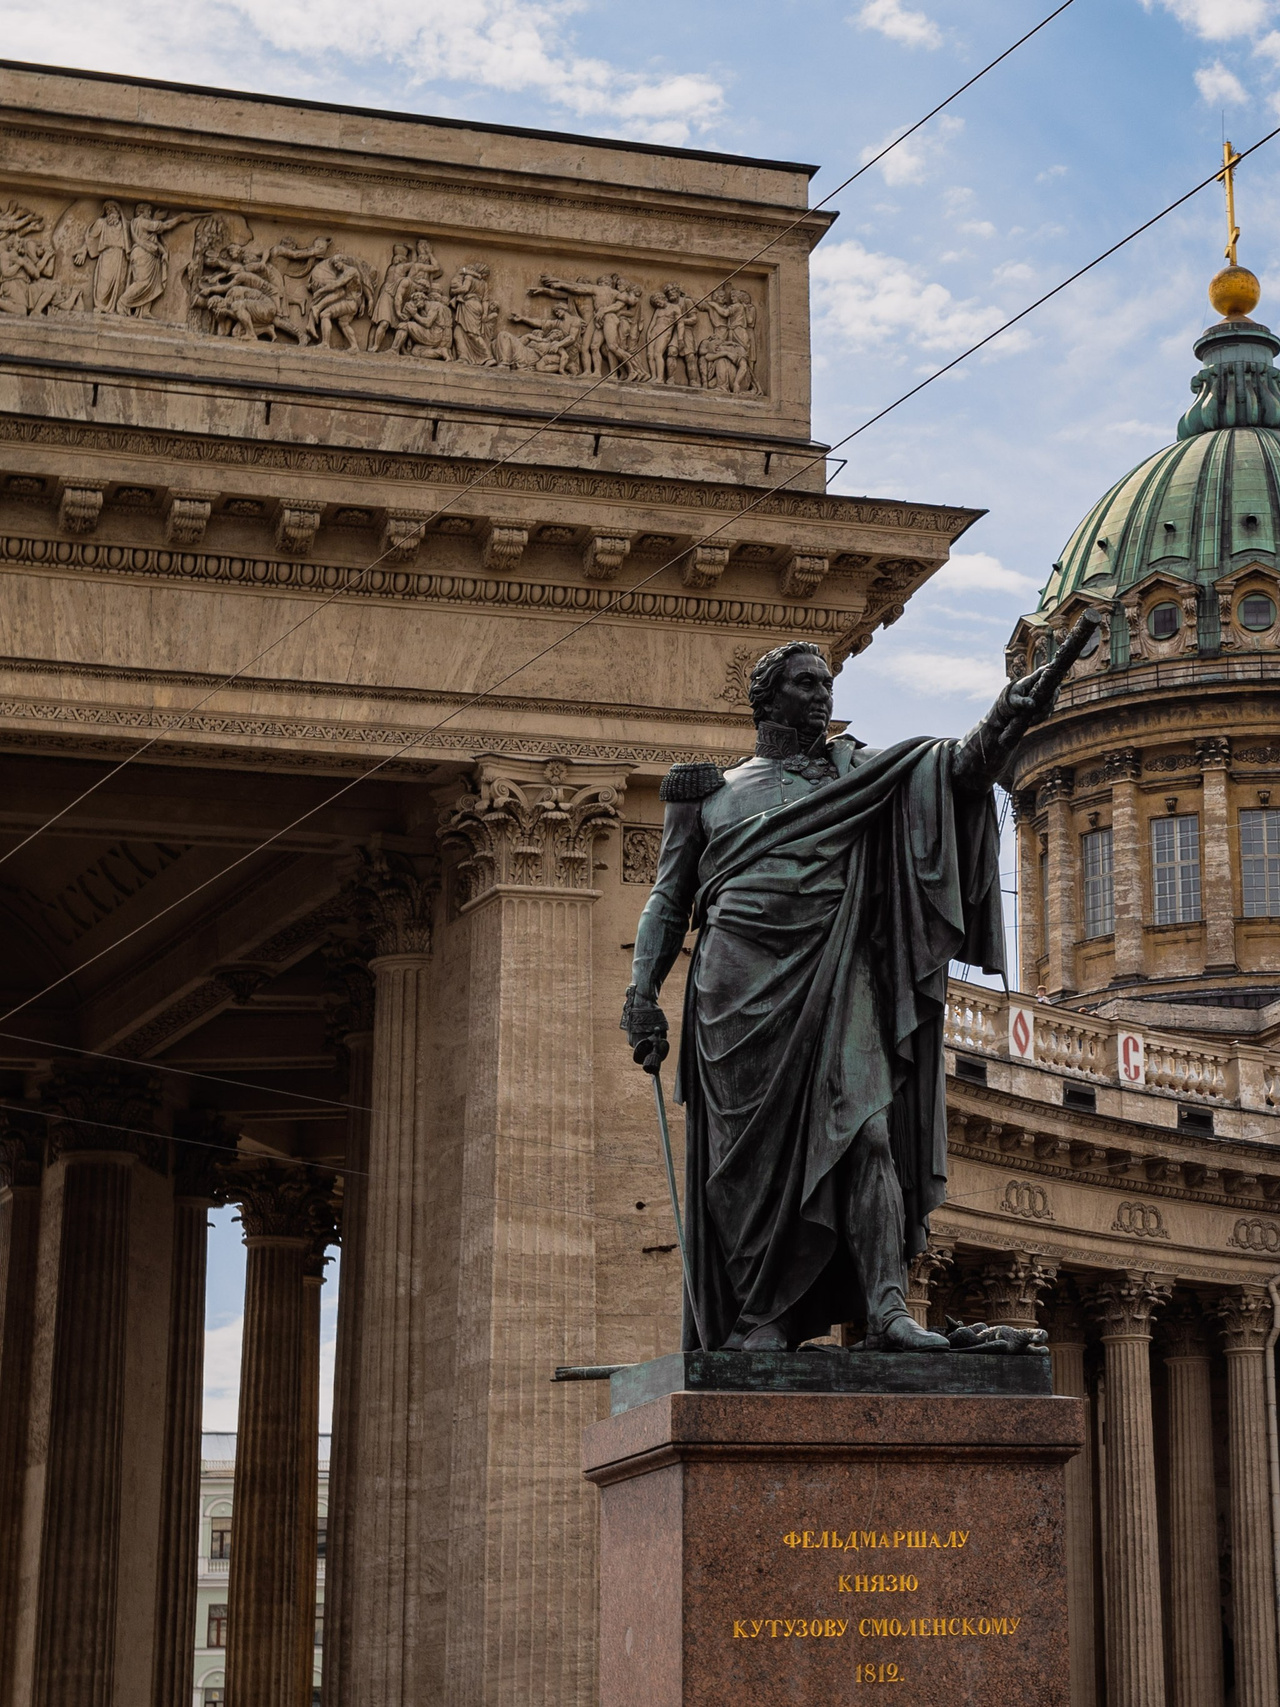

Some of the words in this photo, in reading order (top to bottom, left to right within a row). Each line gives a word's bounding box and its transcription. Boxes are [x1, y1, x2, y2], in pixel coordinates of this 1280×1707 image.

[782, 1530, 971, 1552] ФЕЛЬДМАРШАЛУ
[838, 1573, 919, 1594] КНЯЗЮ
[732, 1618, 850, 1639] КУТУЗОВУ
[858, 1616, 1022, 1638] СМОЛЕНСКОМУ
[855, 1662, 906, 1684] 1812.
